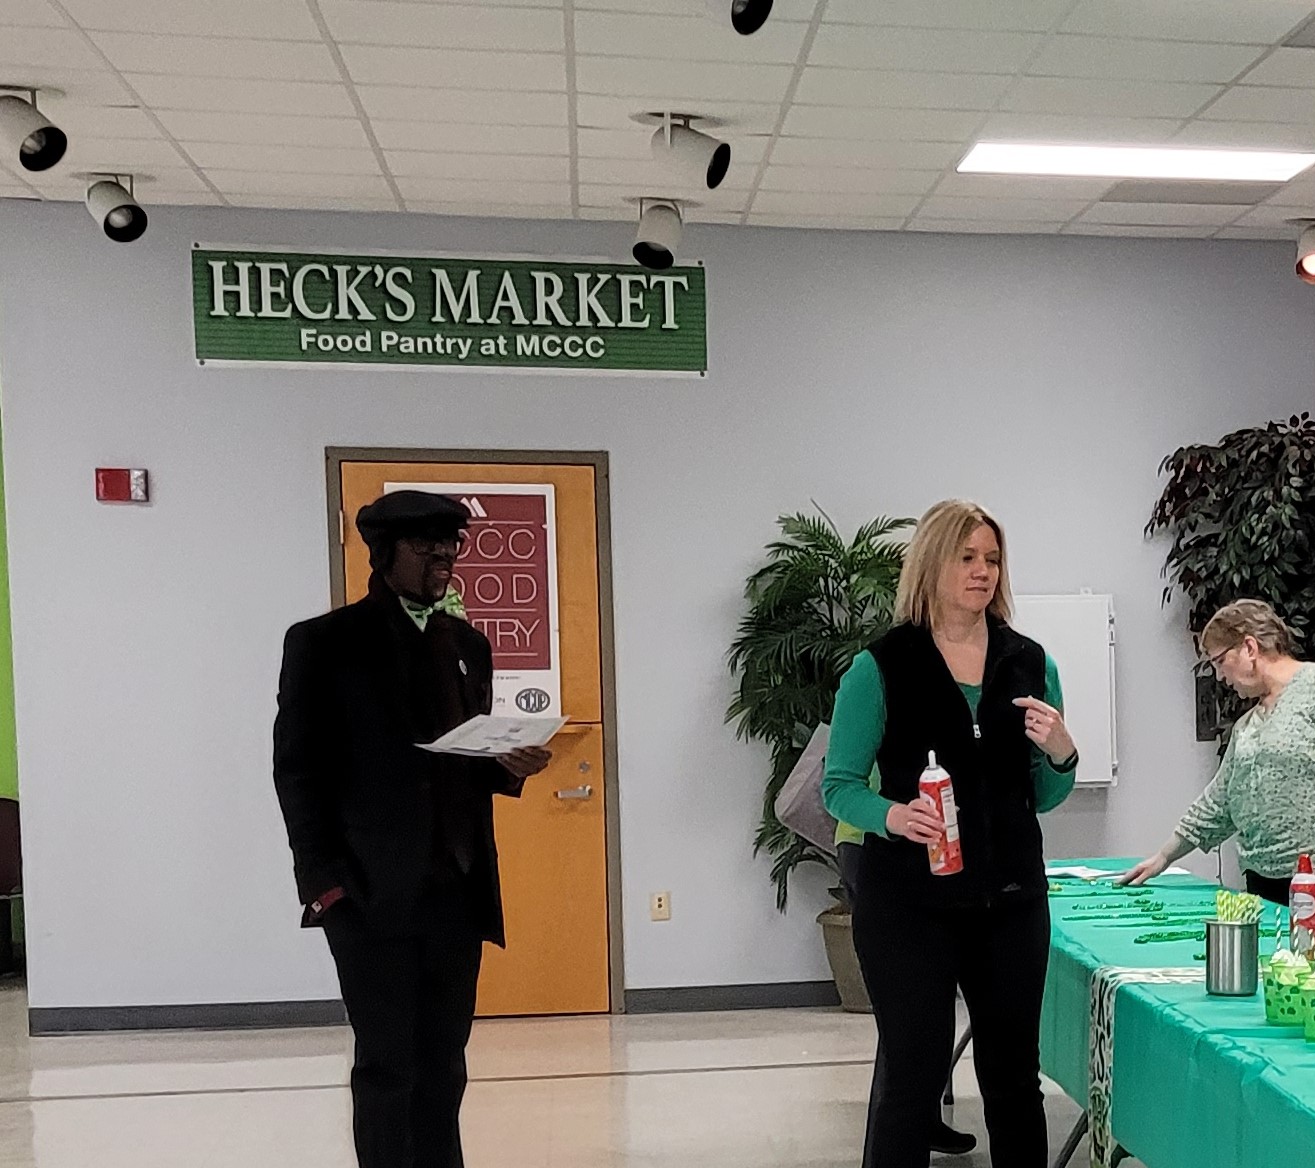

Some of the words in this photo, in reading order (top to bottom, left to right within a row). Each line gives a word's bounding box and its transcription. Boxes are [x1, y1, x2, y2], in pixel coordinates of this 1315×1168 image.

[207, 259, 416, 323] HECK'S
[430, 267, 689, 330] MARKET
[300, 328, 372, 353] Food
[380, 330, 473, 360] Pantry
[480, 335, 508, 357] at
[516, 335, 606, 358] MCCC
[456, 528, 536, 560] CCC
[451, 573, 537, 604] OD
[472, 618, 541, 648] TRY
